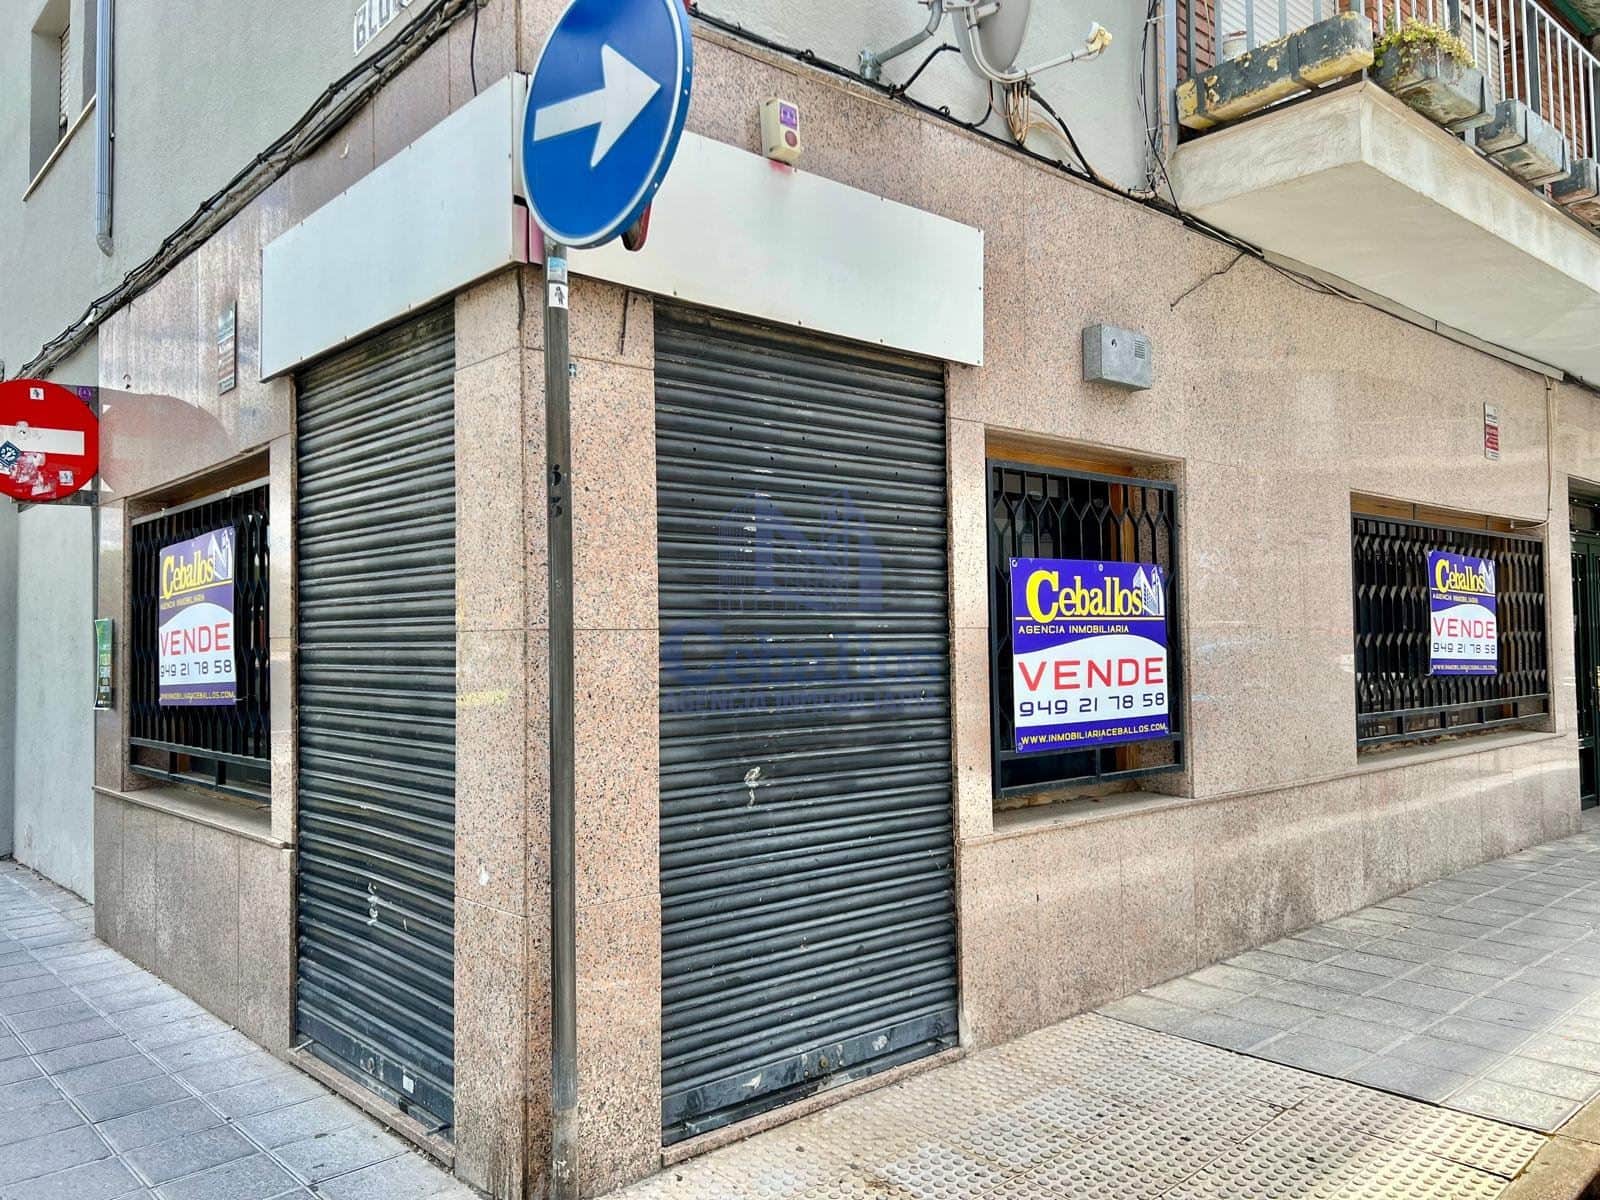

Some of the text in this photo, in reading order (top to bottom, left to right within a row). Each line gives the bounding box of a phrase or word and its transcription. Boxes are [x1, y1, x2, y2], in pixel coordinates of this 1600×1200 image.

[163, 550, 214, 599] Ceballos
[1436, 559, 1486, 593] Ceballos
[1026, 569, 1143, 623] Ceballos
[160, 622, 231, 657] VENDE
[1018, 624, 1129, 634] AGENCIA INMOBILIARIA
[1433, 617, 1495, 639] VENDE
[1433, 642, 1496, 654] 949 21 78 58
[160, 659, 232, 677] 949 21 78 58
[1018, 657, 1164, 692] VENDE
[1019, 692, 1165, 717] 949 21 78 58
